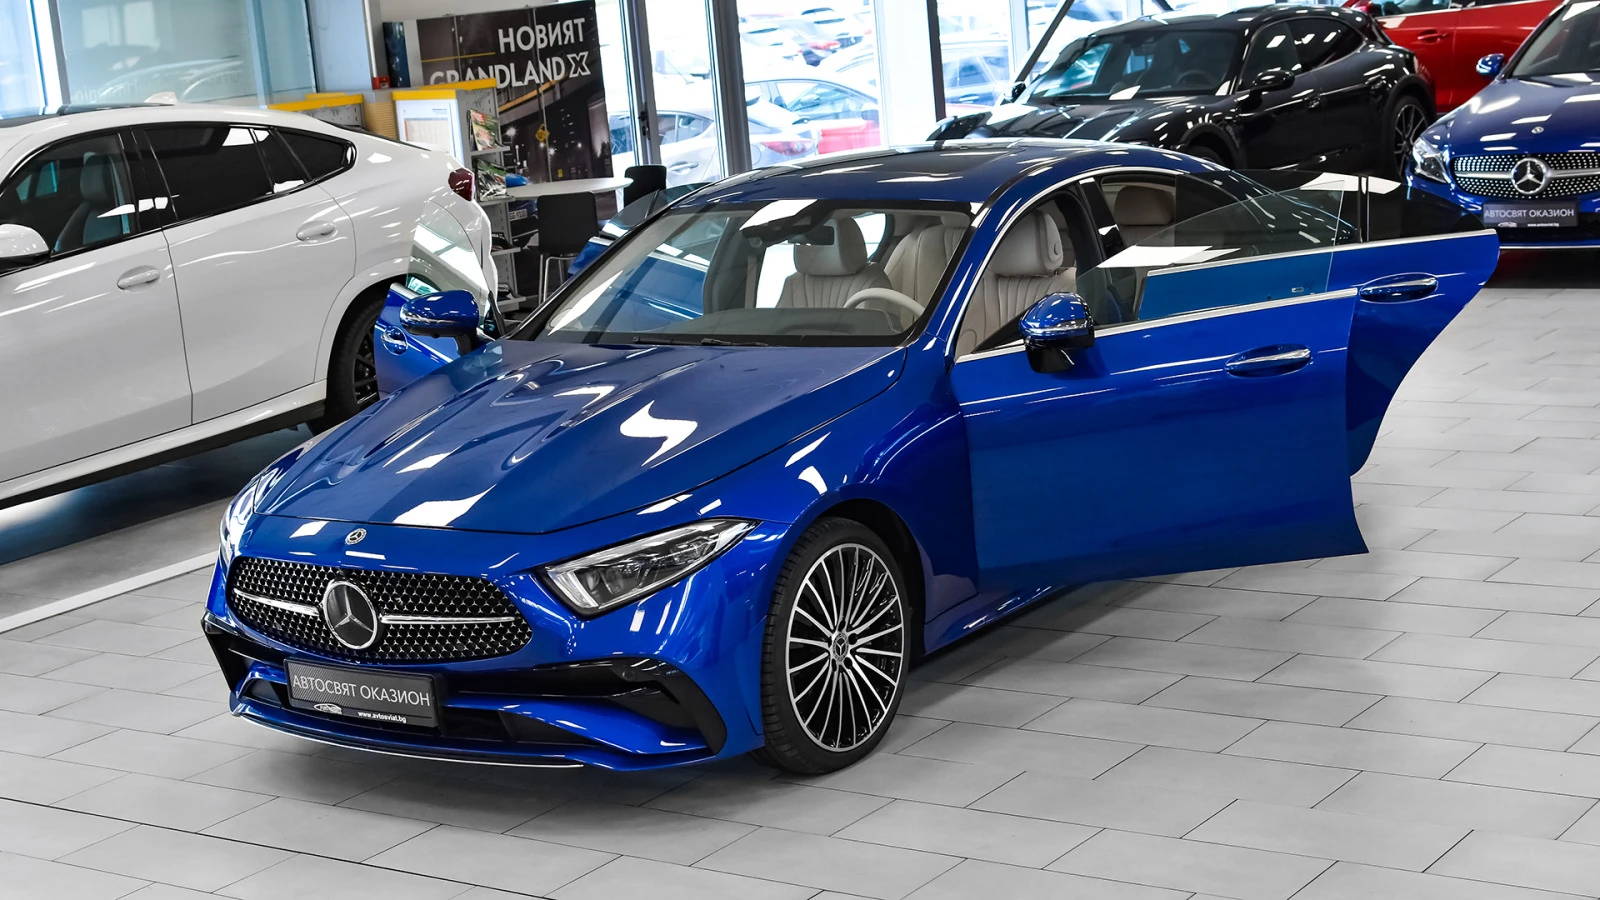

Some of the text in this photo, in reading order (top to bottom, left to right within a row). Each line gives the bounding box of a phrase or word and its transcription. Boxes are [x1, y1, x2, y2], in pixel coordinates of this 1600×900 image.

[498, 18, 585, 53] НОВИЯТ
[1484, 208, 1575, 218] АВТОСВЯТ ОКАЗИОН
[292, 675, 431, 707] АВТОСВЯТ ОКАЗИОН
